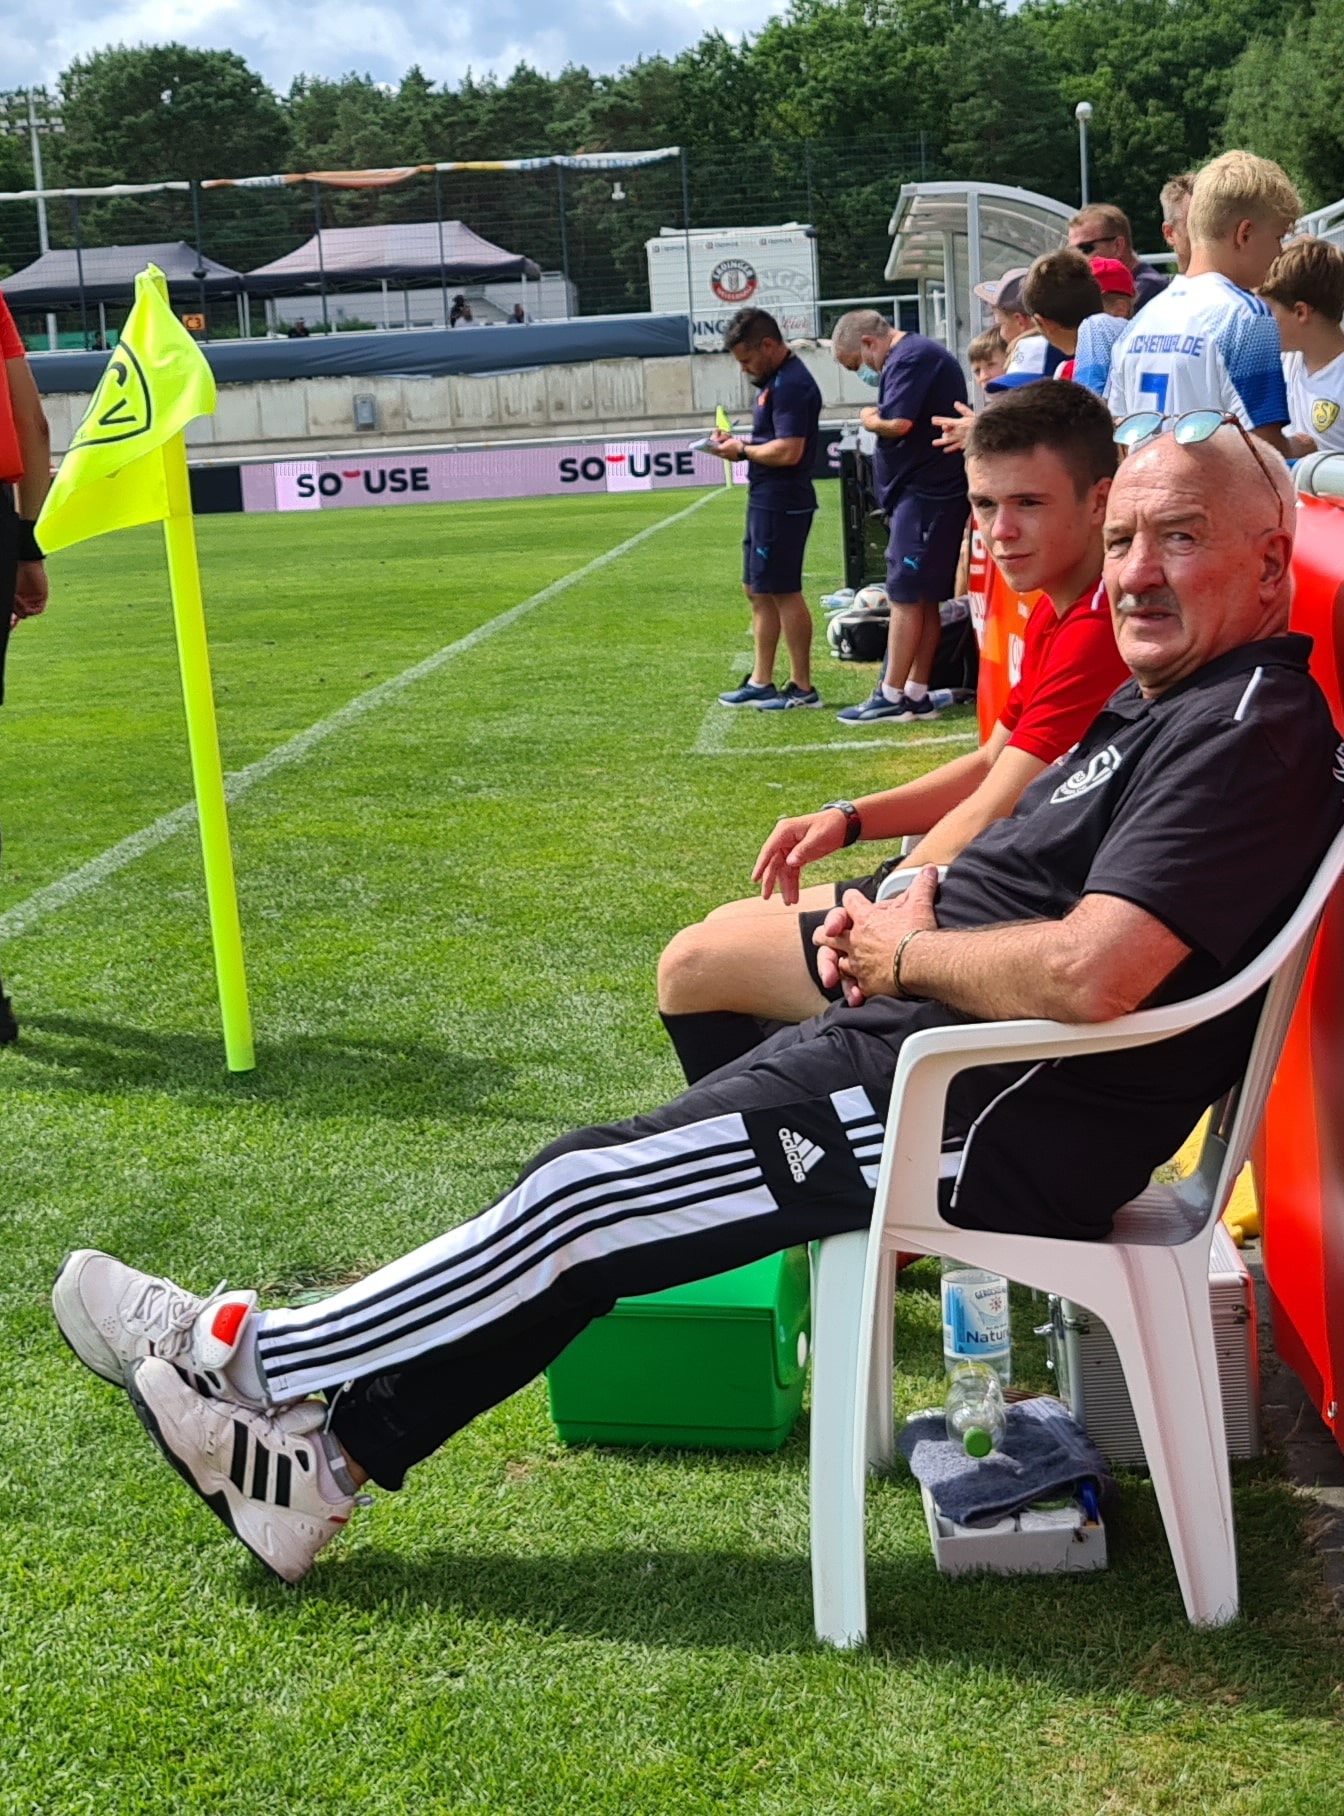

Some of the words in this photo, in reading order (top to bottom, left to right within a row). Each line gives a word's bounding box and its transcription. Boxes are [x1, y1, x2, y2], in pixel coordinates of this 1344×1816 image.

[185, 316, 202, 329] C3
[1139, 372, 1170, 414] 7
[778, 1127, 806, 1184] adidas
